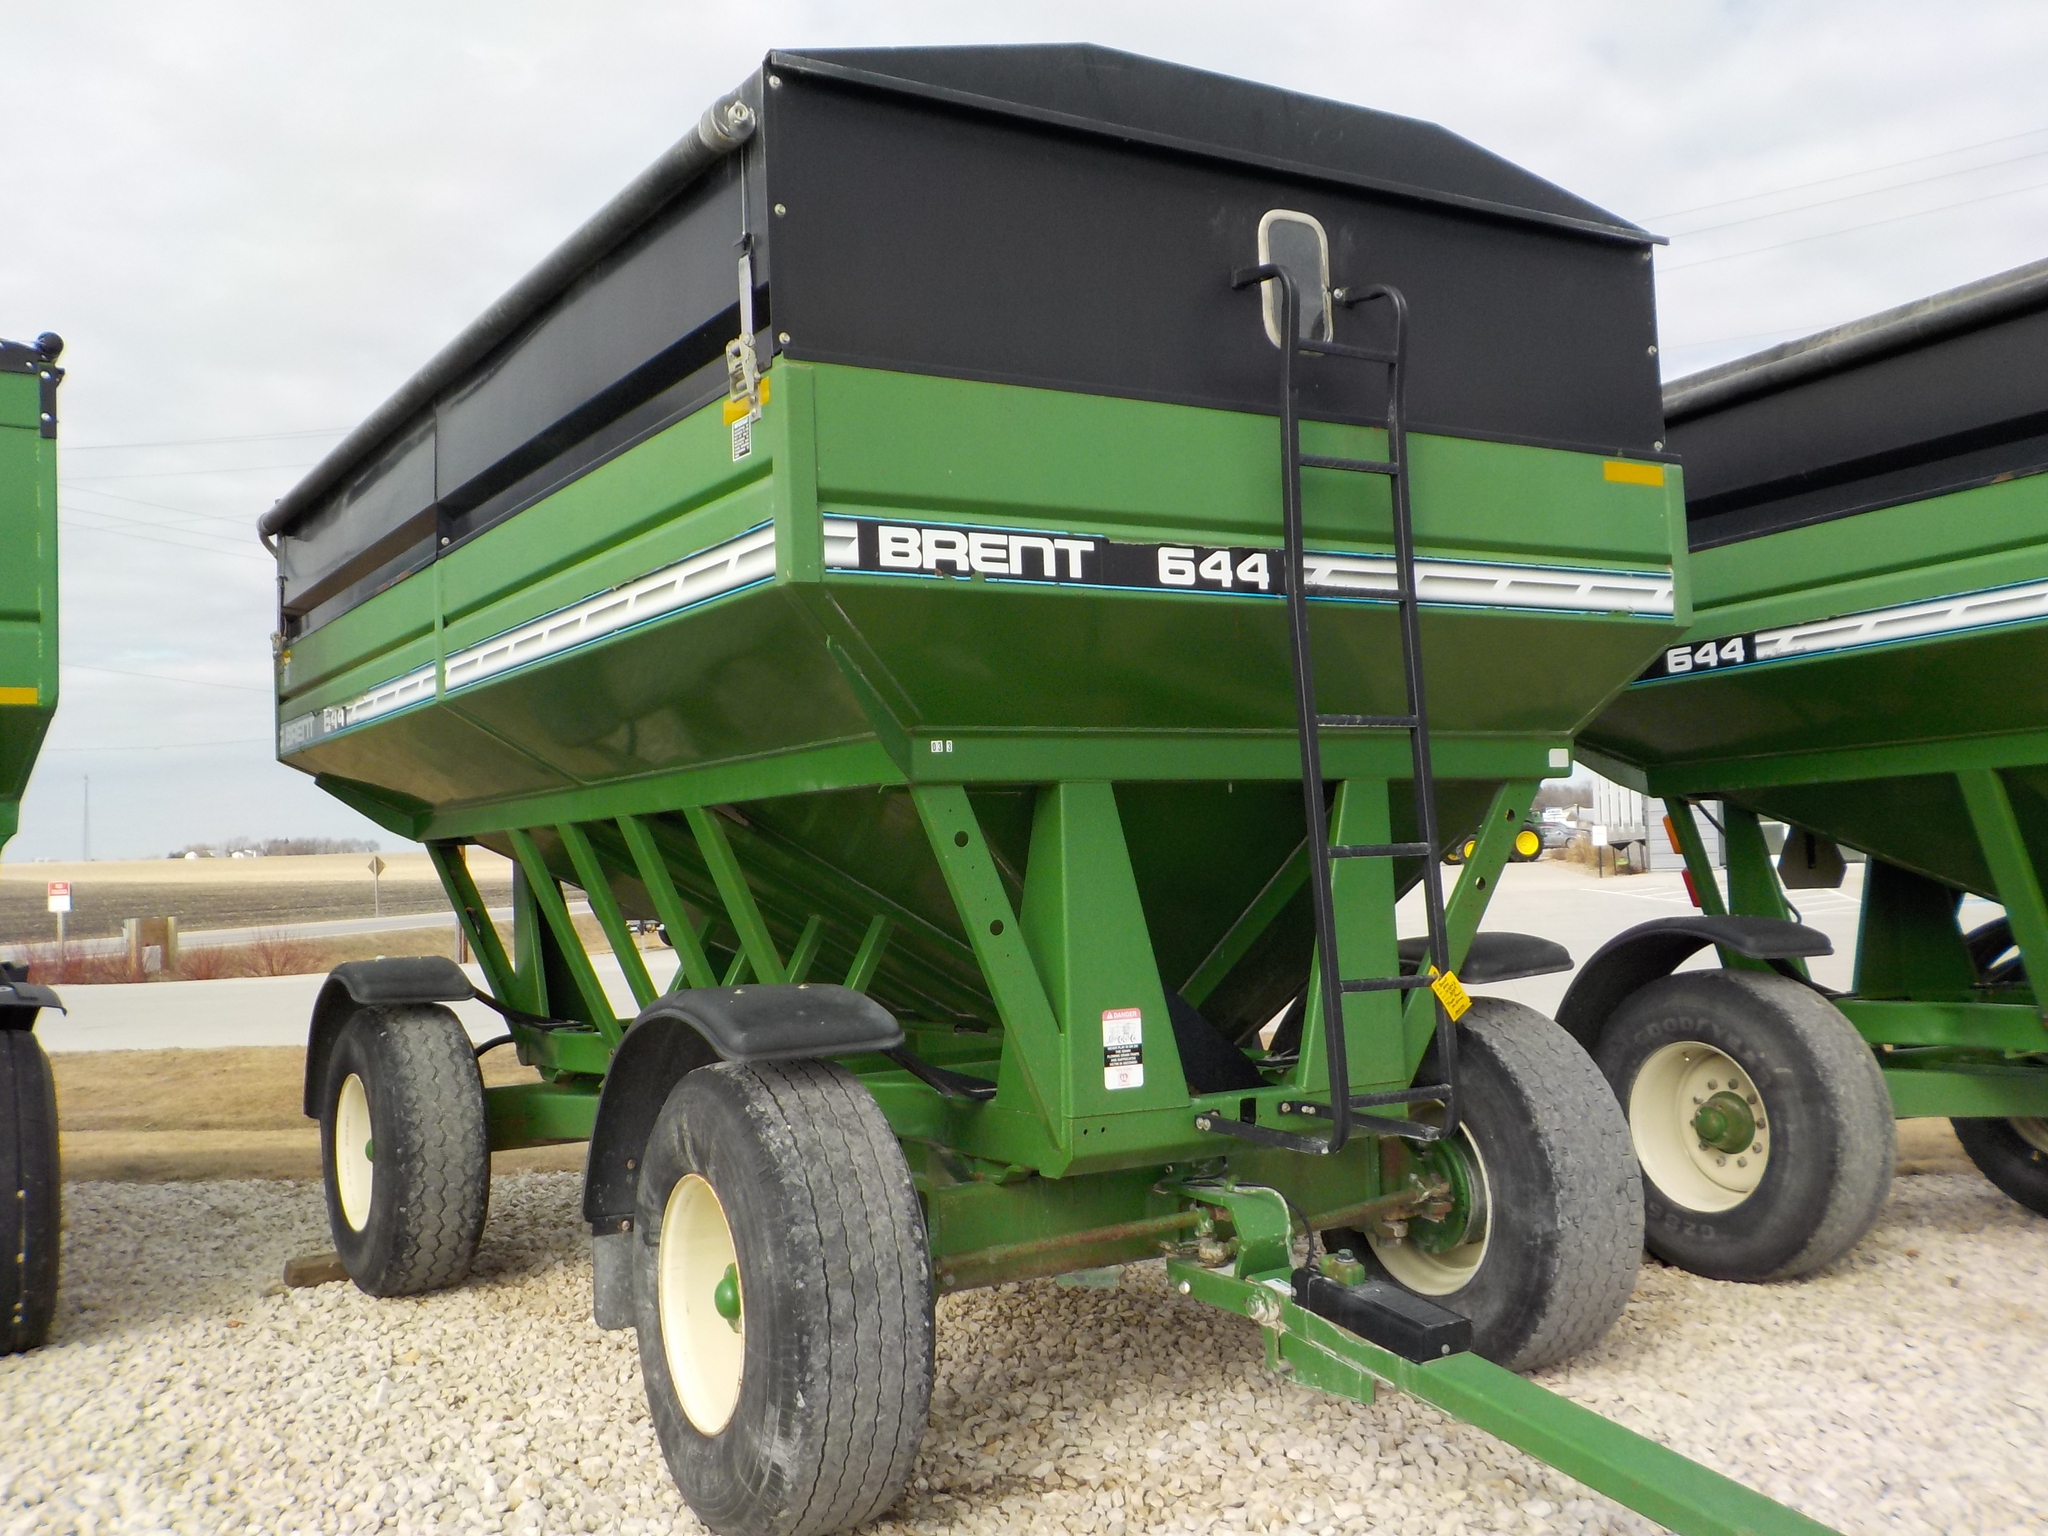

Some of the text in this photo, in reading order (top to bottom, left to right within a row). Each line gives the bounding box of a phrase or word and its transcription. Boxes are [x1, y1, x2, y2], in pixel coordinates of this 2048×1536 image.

[878, 525, 1270, 590] BRENT 644
[1667, 637, 1745, 674] 644
[323, 707, 345, 733] 644
[1113, 1010, 1137, 1019] DANGER
